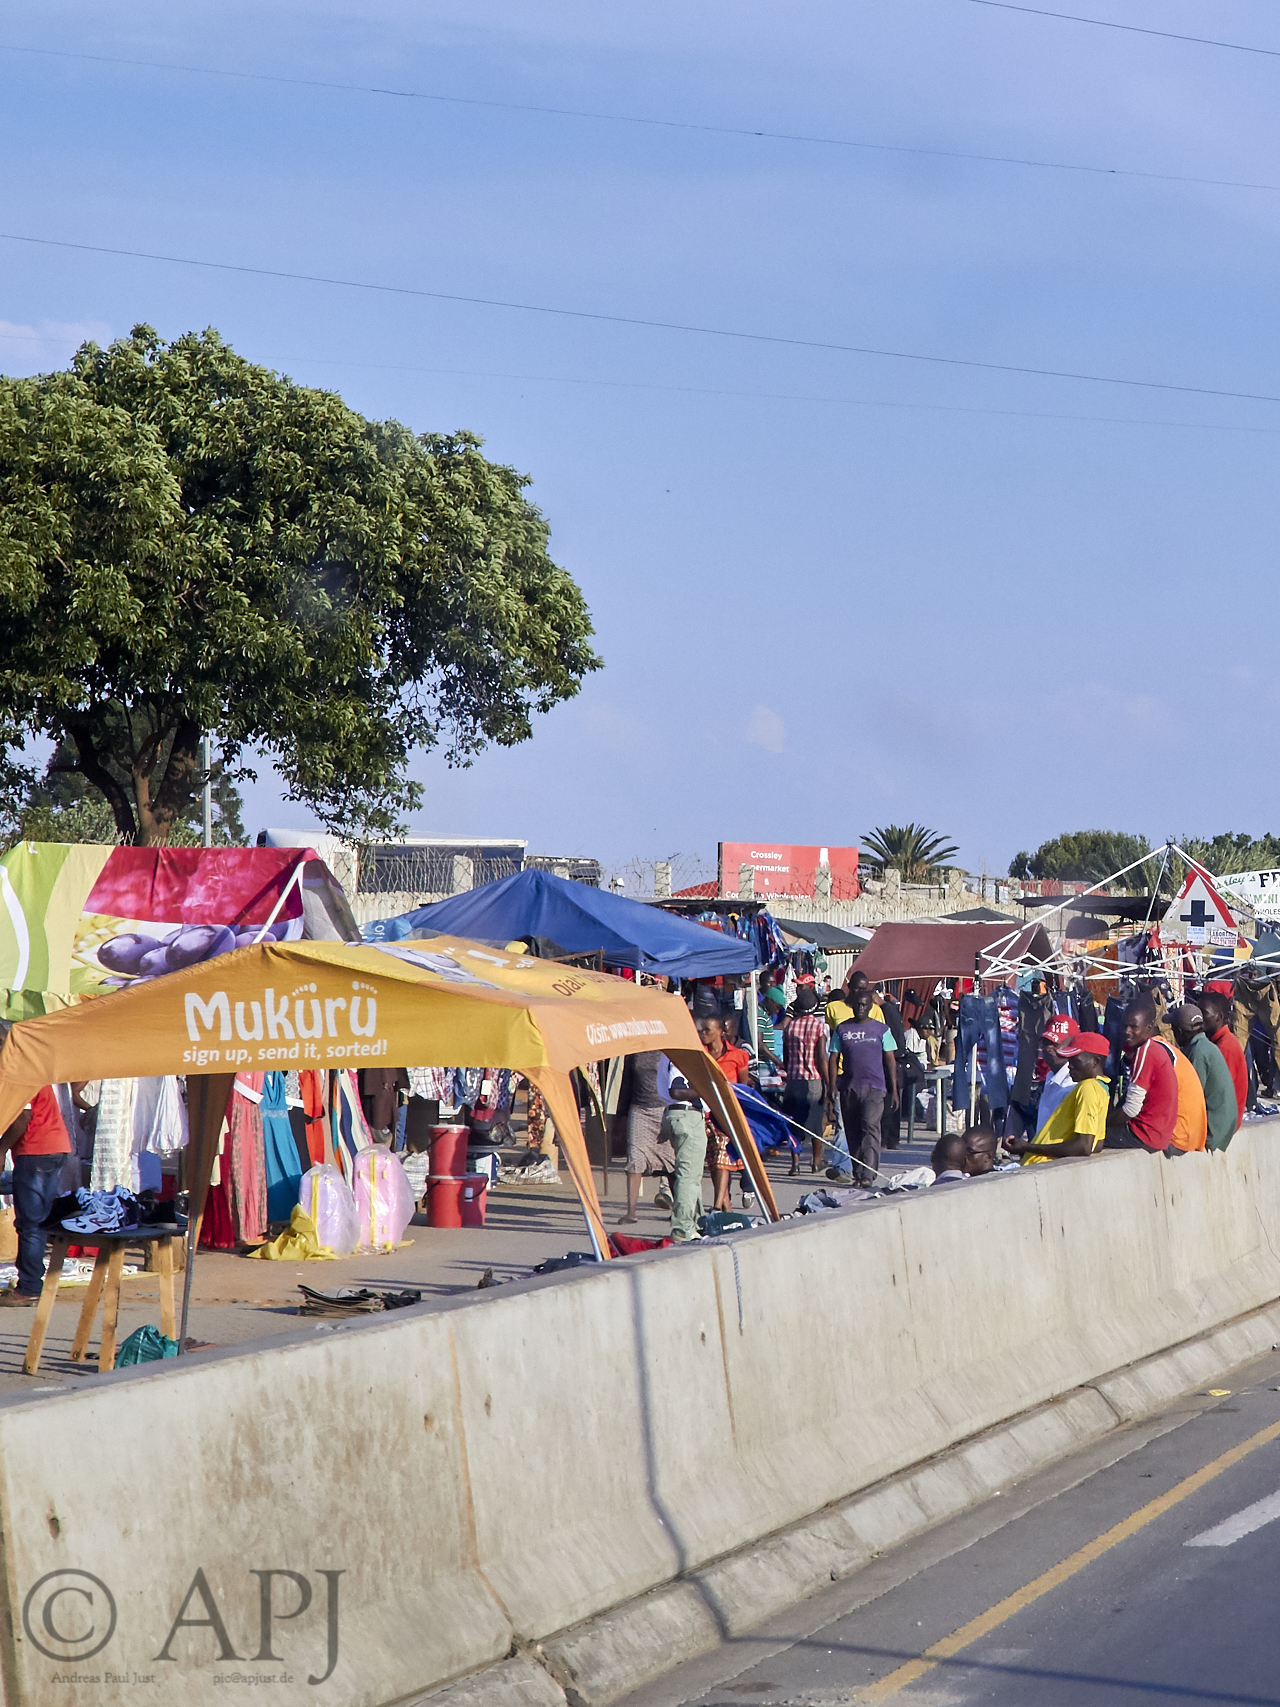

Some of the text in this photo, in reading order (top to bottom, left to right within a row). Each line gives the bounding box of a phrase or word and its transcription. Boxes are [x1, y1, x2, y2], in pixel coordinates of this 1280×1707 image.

[750, 850, 783, 860] Crossley
[586, 1022, 611, 1045] Visit:
[182, 1039, 388, 1066] sign up, send it, sorted!
